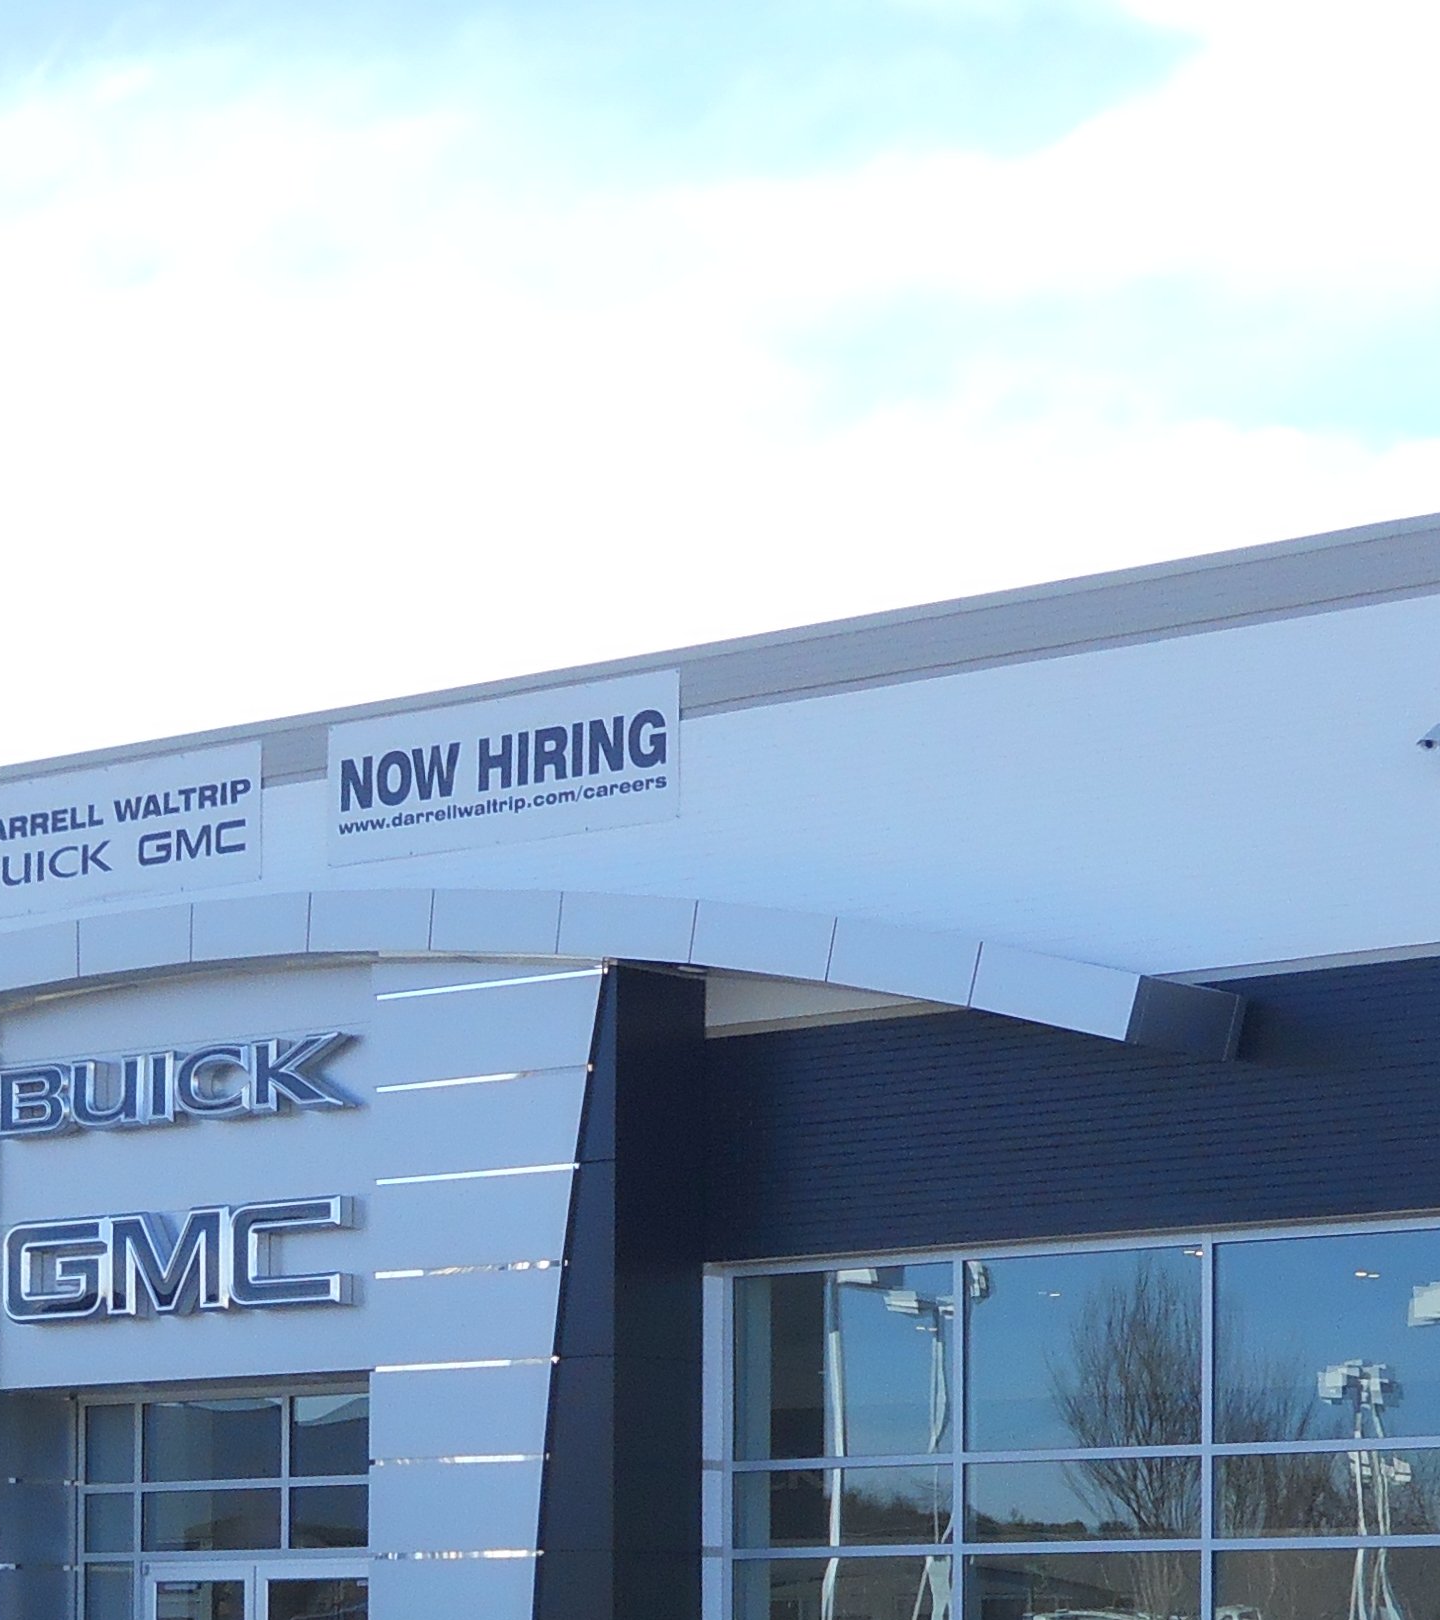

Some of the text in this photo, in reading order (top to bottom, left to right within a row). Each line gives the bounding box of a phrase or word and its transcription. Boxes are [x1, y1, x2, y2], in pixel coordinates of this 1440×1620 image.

[340, 709, 667, 813] NOW HIRING
[113, 779, 252, 823] WALTRIP
[338, 775, 667, 836] www.darrellwaltrip.com/careers
[138, 818, 247, 867] GMC
[2, 1195, 352, 1325] GMC
